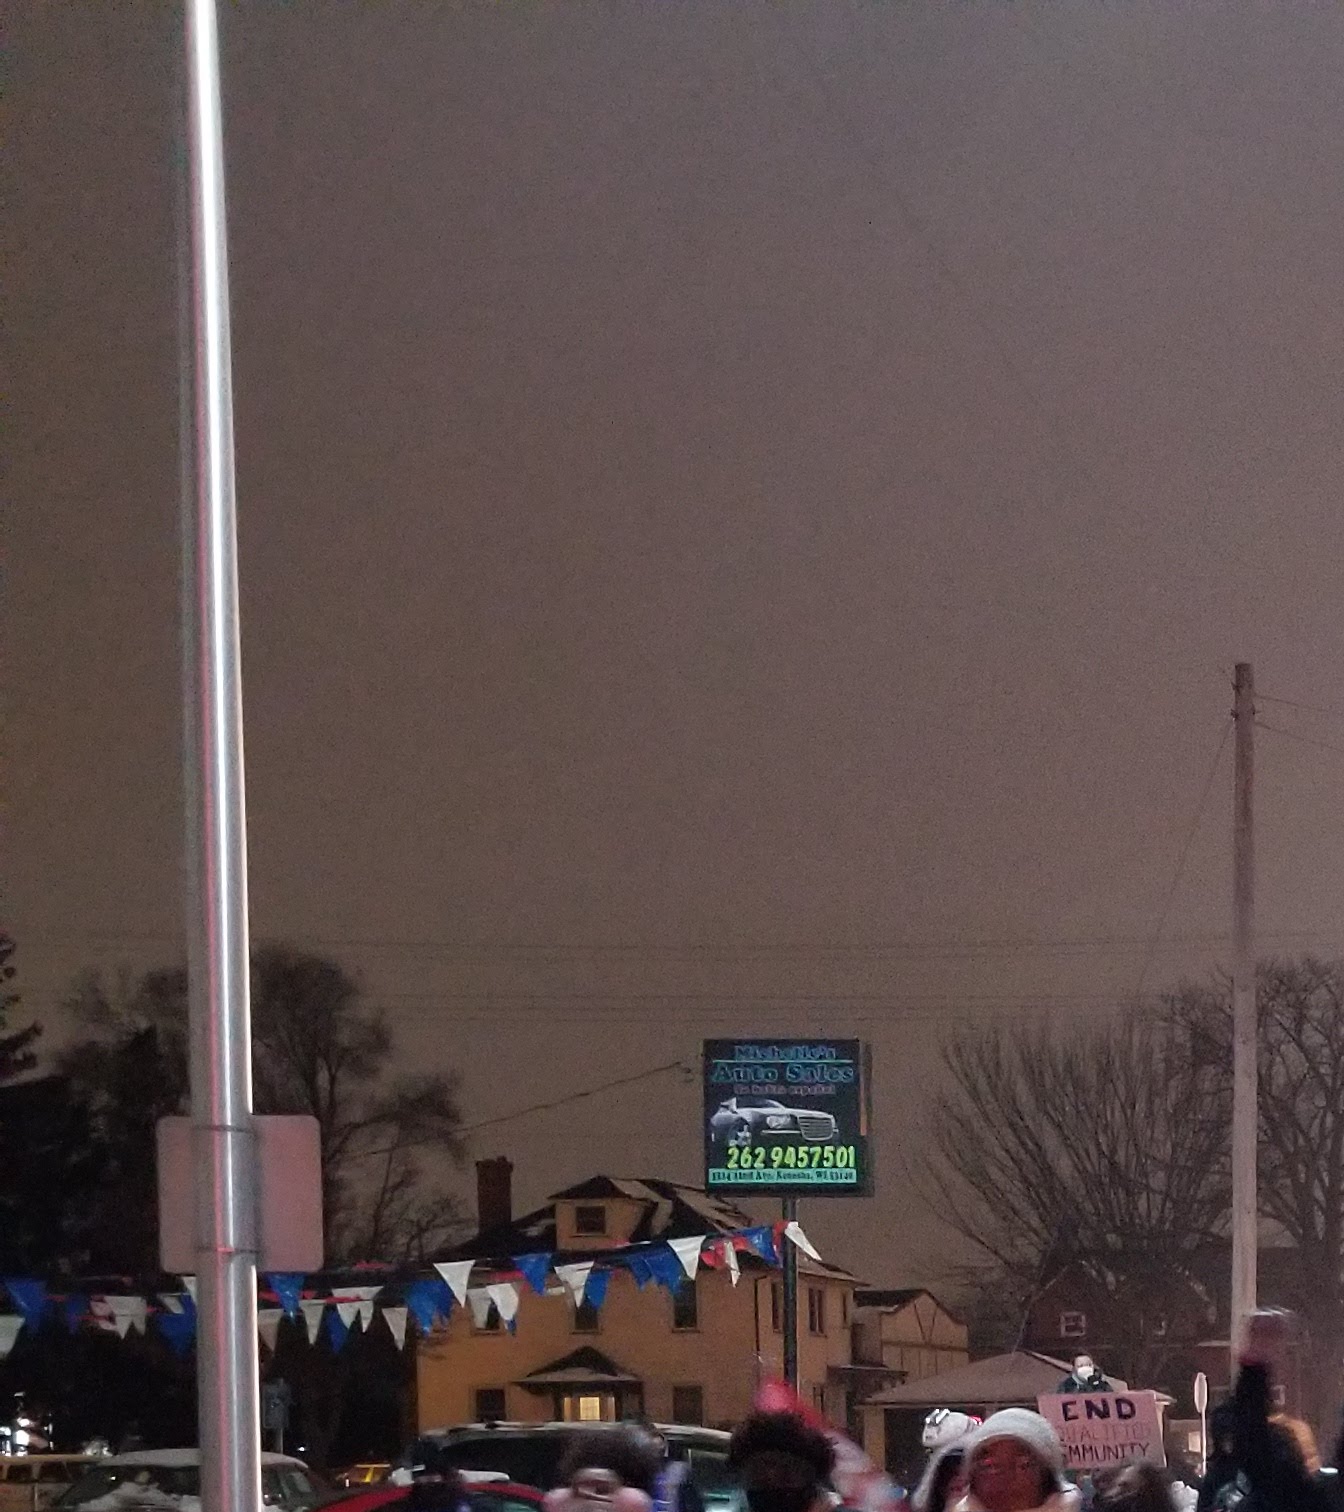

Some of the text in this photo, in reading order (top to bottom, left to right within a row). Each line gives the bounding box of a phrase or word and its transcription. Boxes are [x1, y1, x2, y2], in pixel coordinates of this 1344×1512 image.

[712, 1062, 854, 1083] Auto Sales
[727, 1146, 856, 1169] 262 9457501
[1062, 1398, 1137, 1422] END
